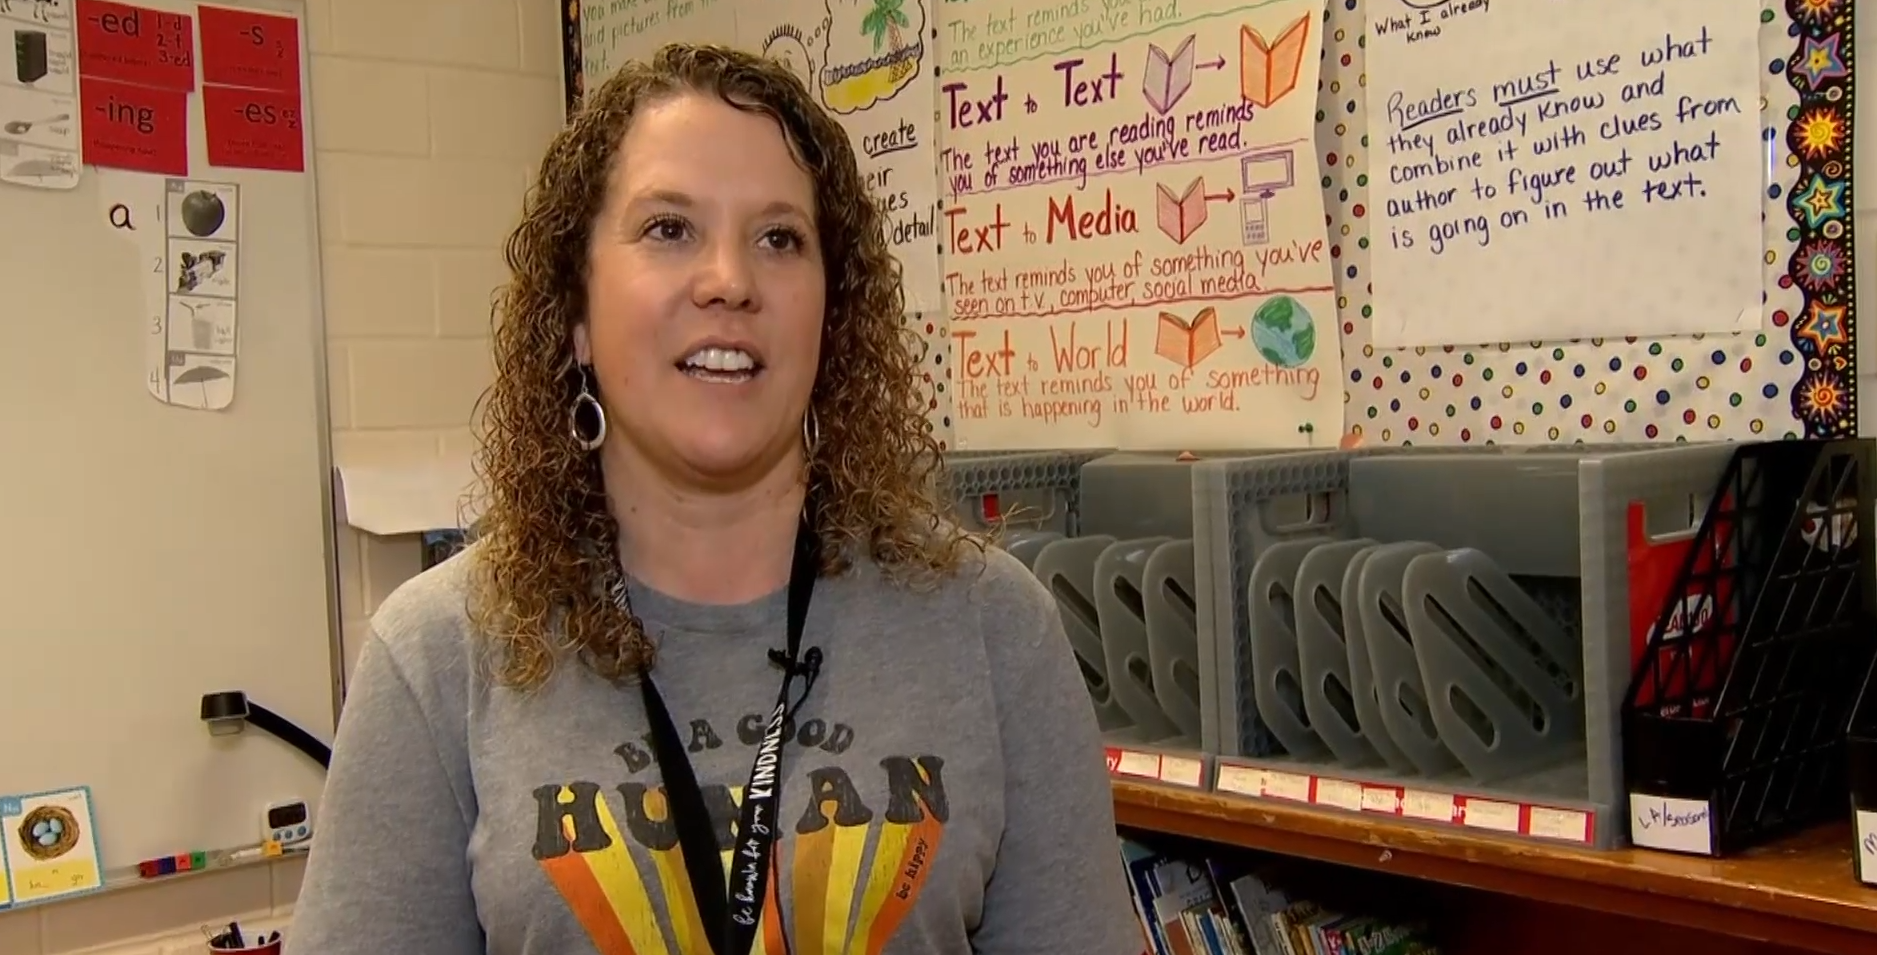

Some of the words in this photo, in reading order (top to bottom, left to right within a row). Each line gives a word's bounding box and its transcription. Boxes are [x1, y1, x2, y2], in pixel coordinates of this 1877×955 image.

[612, 11, 661, 49] pictures
[948, 19, 976, 43] The
[987, 8, 1017, 35] text
[1027, 0, 1090, 27] reminds
[950, 48, 969, 65] an
[979, 24, 1066, 65] experience
[1073, 10, 1128, 48] you've
[1139, 0, 1181, 25] had.
[1375, 14, 1412, 35] What
[1419, 10, 1431, 25] I
[942, 75, 1008, 129] Text
[1023, 93, 1038, 115] to
[1053, 52, 1125, 107] Text
[1387, 88, 1477, 127] Readers
[1493, 59, 1562, 104] must
[1577, 53, 1621, 80] use
[1641, 26, 1713, 67] what
[863, 117, 916, 155] create
[940, 147, 973, 172] The
[985, 136, 1019, 165] text
[1032, 140, 1061, 169] you
[1068, 131, 1098, 153] are
[1110, 112, 1175, 146] reading
[1186, 94, 1254, 132] reminds
[1387, 133, 1434, 157] they
[1446, 106, 1527, 144] already
[1621, 70, 1665, 102] and
[949, 172, 973, 203] you
[984, 162, 998, 187] of
[1009, 157, 1087, 191] something
[1095, 143, 1126, 169] else
[1135, 137, 1190, 176] you've
[1198, 122, 1248, 154] read.
[1390, 151, 1483, 184] combine
[1498, 139, 1518, 162] it
[1533, 124, 1586, 155] with
[1600, 112, 1663, 139] clues
[1676, 95, 1742, 123] from
[1387, 187, 1457, 217] author
[1471, 177, 1497, 200] to
[1507, 165, 1576, 204] figure
[1590, 148, 1633, 180] out
[1649, 130, 1721, 172] what
[109, 203, 137, 230] a
[893, 204, 934, 245] detail
[944, 203, 1011, 254] Text
[1022, 221, 1037, 245] to
[1046, 188, 1139, 244] Media
[1391, 226, 1414, 249] is
[1429, 215, 1490, 255] going
[1500, 209, 1528, 228] on
[1545, 199, 1567, 219] in
[1583, 189, 1624, 212] the
[1642, 171, 1706, 203] text.
[153, 257, 163, 273] 2
[945, 272, 974, 297] The
[982, 267, 1008, 292] text
[1015, 258, 1076, 289] reminds
[1085, 262, 1117, 292] you
[1123, 250, 1142, 278] of
[1150, 245, 1244, 277] something
[1255, 239, 1323, 277] you've
[954, 297, 989, 315] seen
[995, 297, 1015, 313] on
[1143, 274, 1192, 299] social
[151, 316, 162, 335] 3
[951, 329, 1015, 378] Text
[1027, 352, 1039, 371] to
[1050, 317, 1127, 374] World
[957, 379, 988, 398] The
[997, 375, 1030, 396] text
[1041, 370, 1112, 395] reminds
[1124, 371, 1157, 402] you
[1169, 366, 1194, 389] of
[1206, 364, 1320, 400] something
[958, 400, 988, 419] that
[999, 400, 1012, 417] is
[1021, 397, 1101, 428] happening
[1113, 395, 1128, 413] in
[1137, 390, 1170, 412] the
[1182, 391, 1240, 414] world.
[688, 719, 723, 752] A
